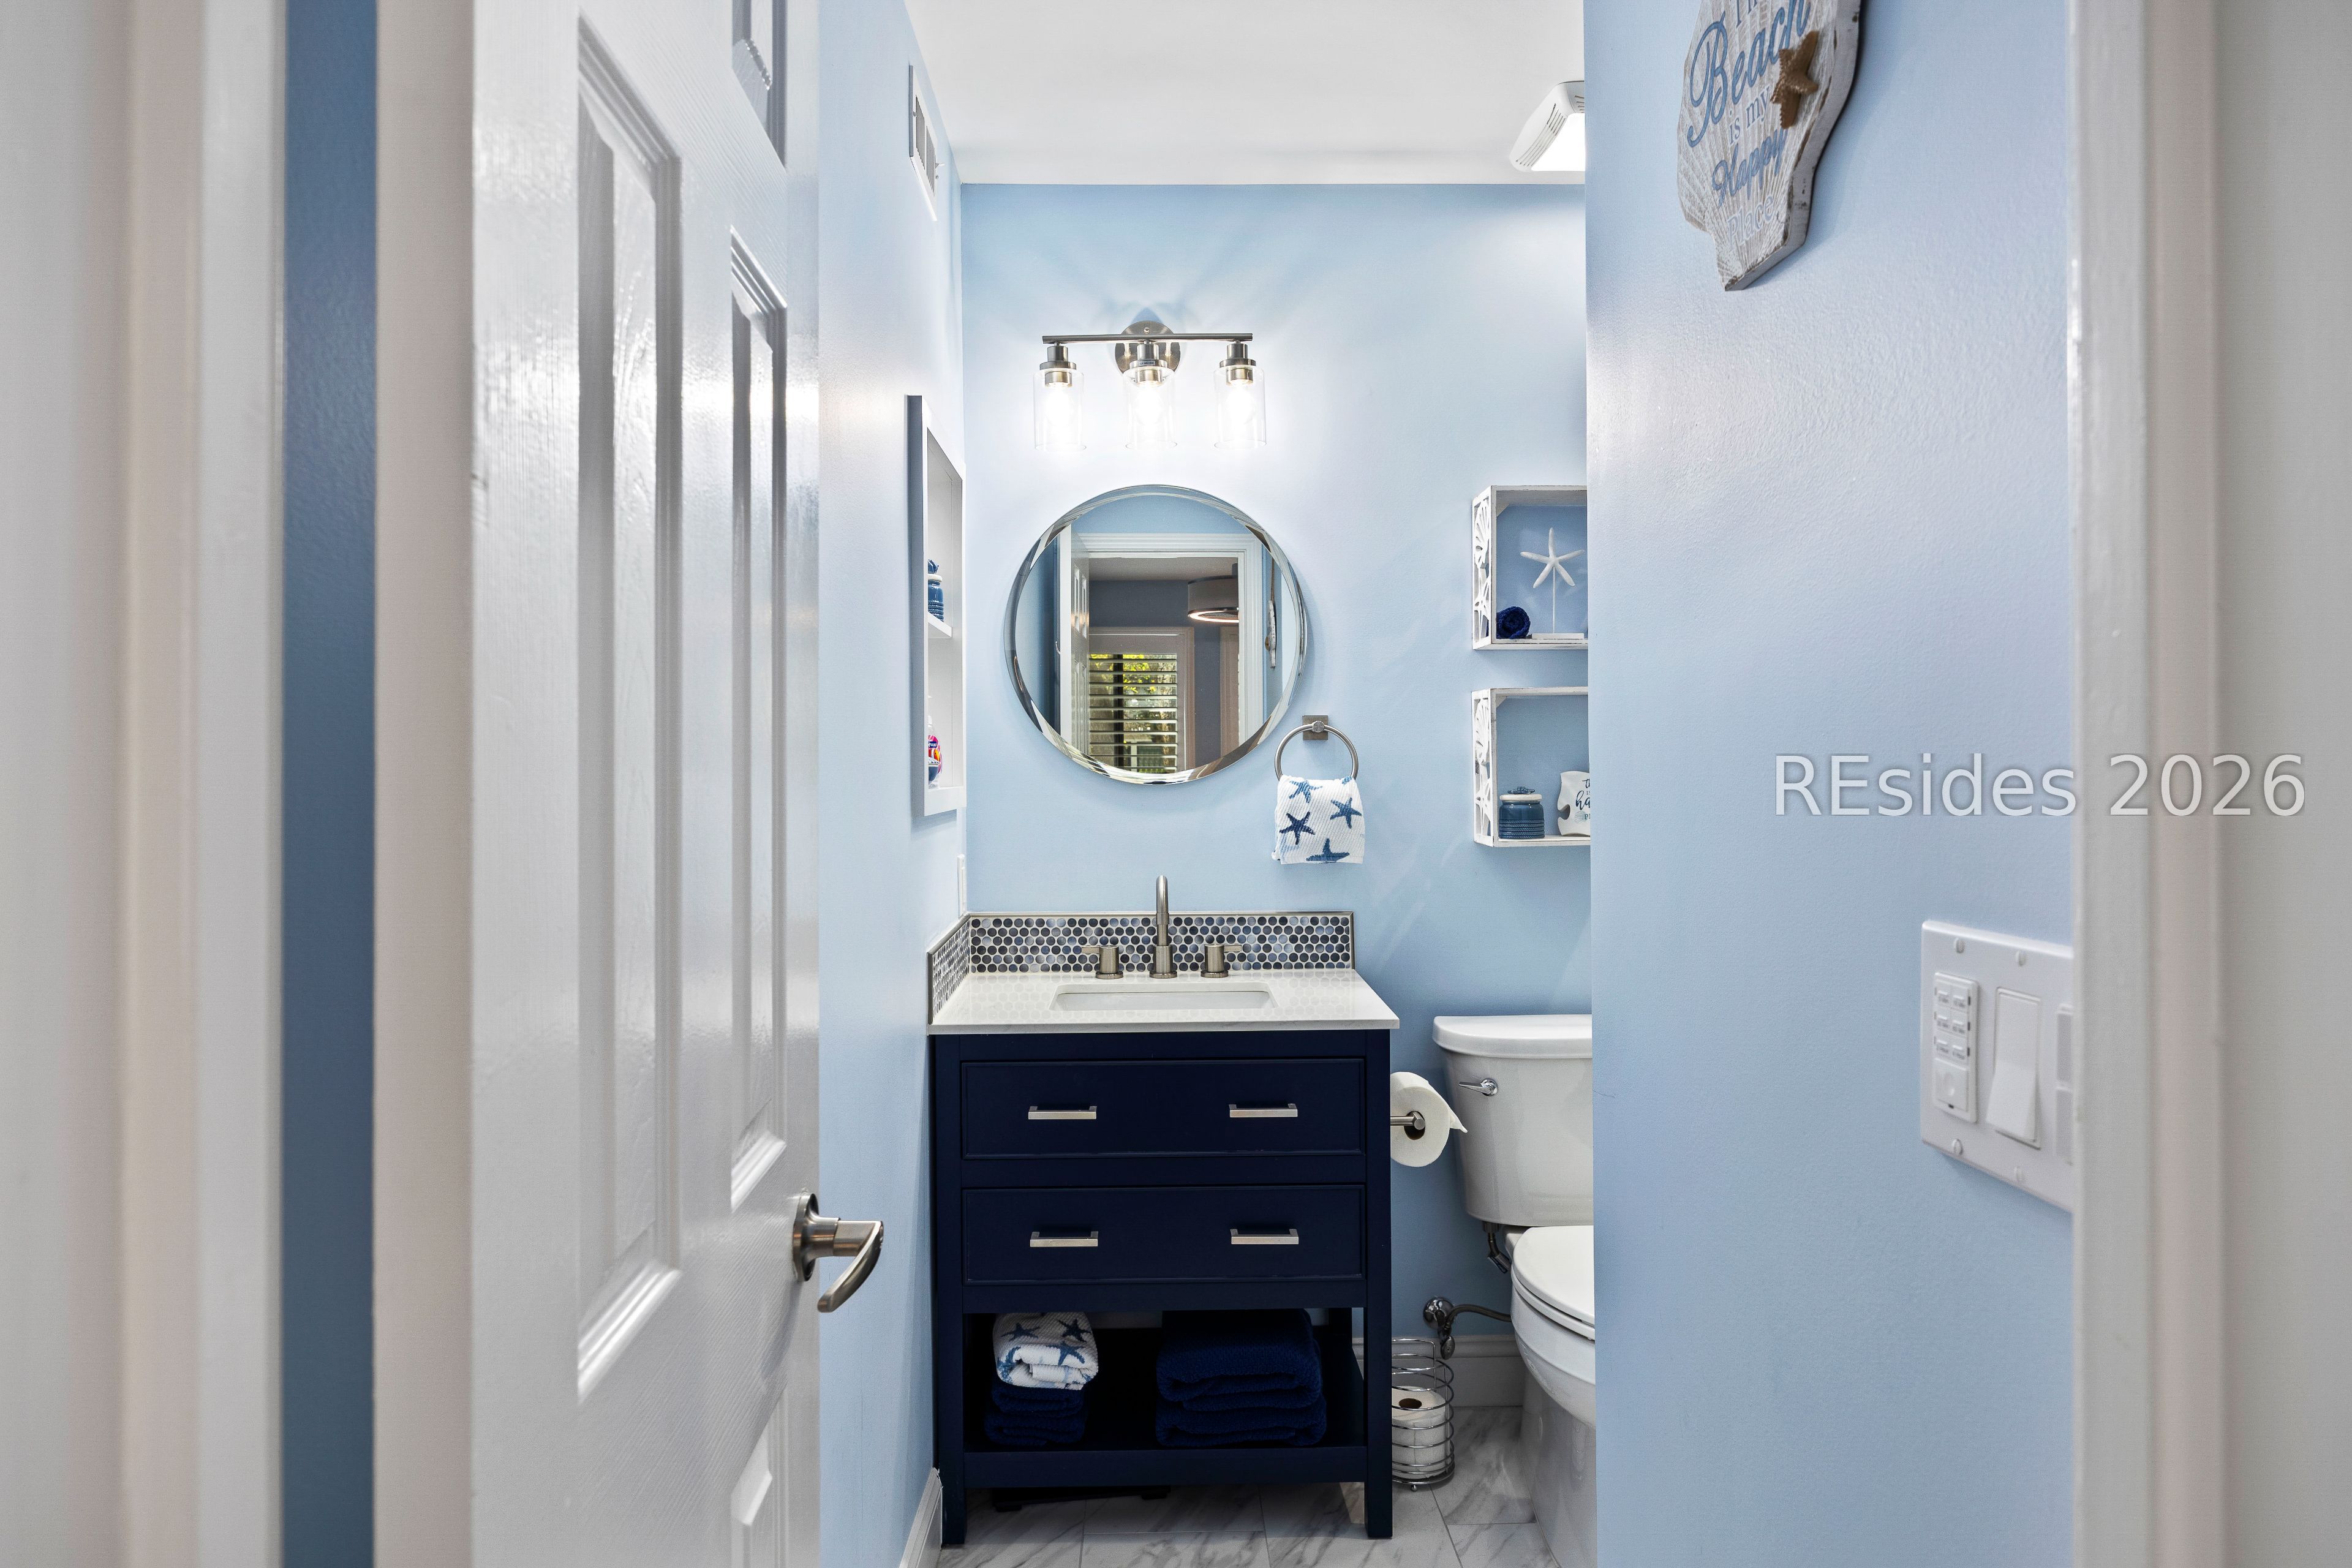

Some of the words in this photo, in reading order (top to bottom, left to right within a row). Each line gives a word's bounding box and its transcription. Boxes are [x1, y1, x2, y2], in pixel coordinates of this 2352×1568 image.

[1729, 110, 1741, 145] is
[1746, 86, 1770, 128] my
[1712, 128, 1788, 206] Happy
[1727, 195, 1774, 243] Place
